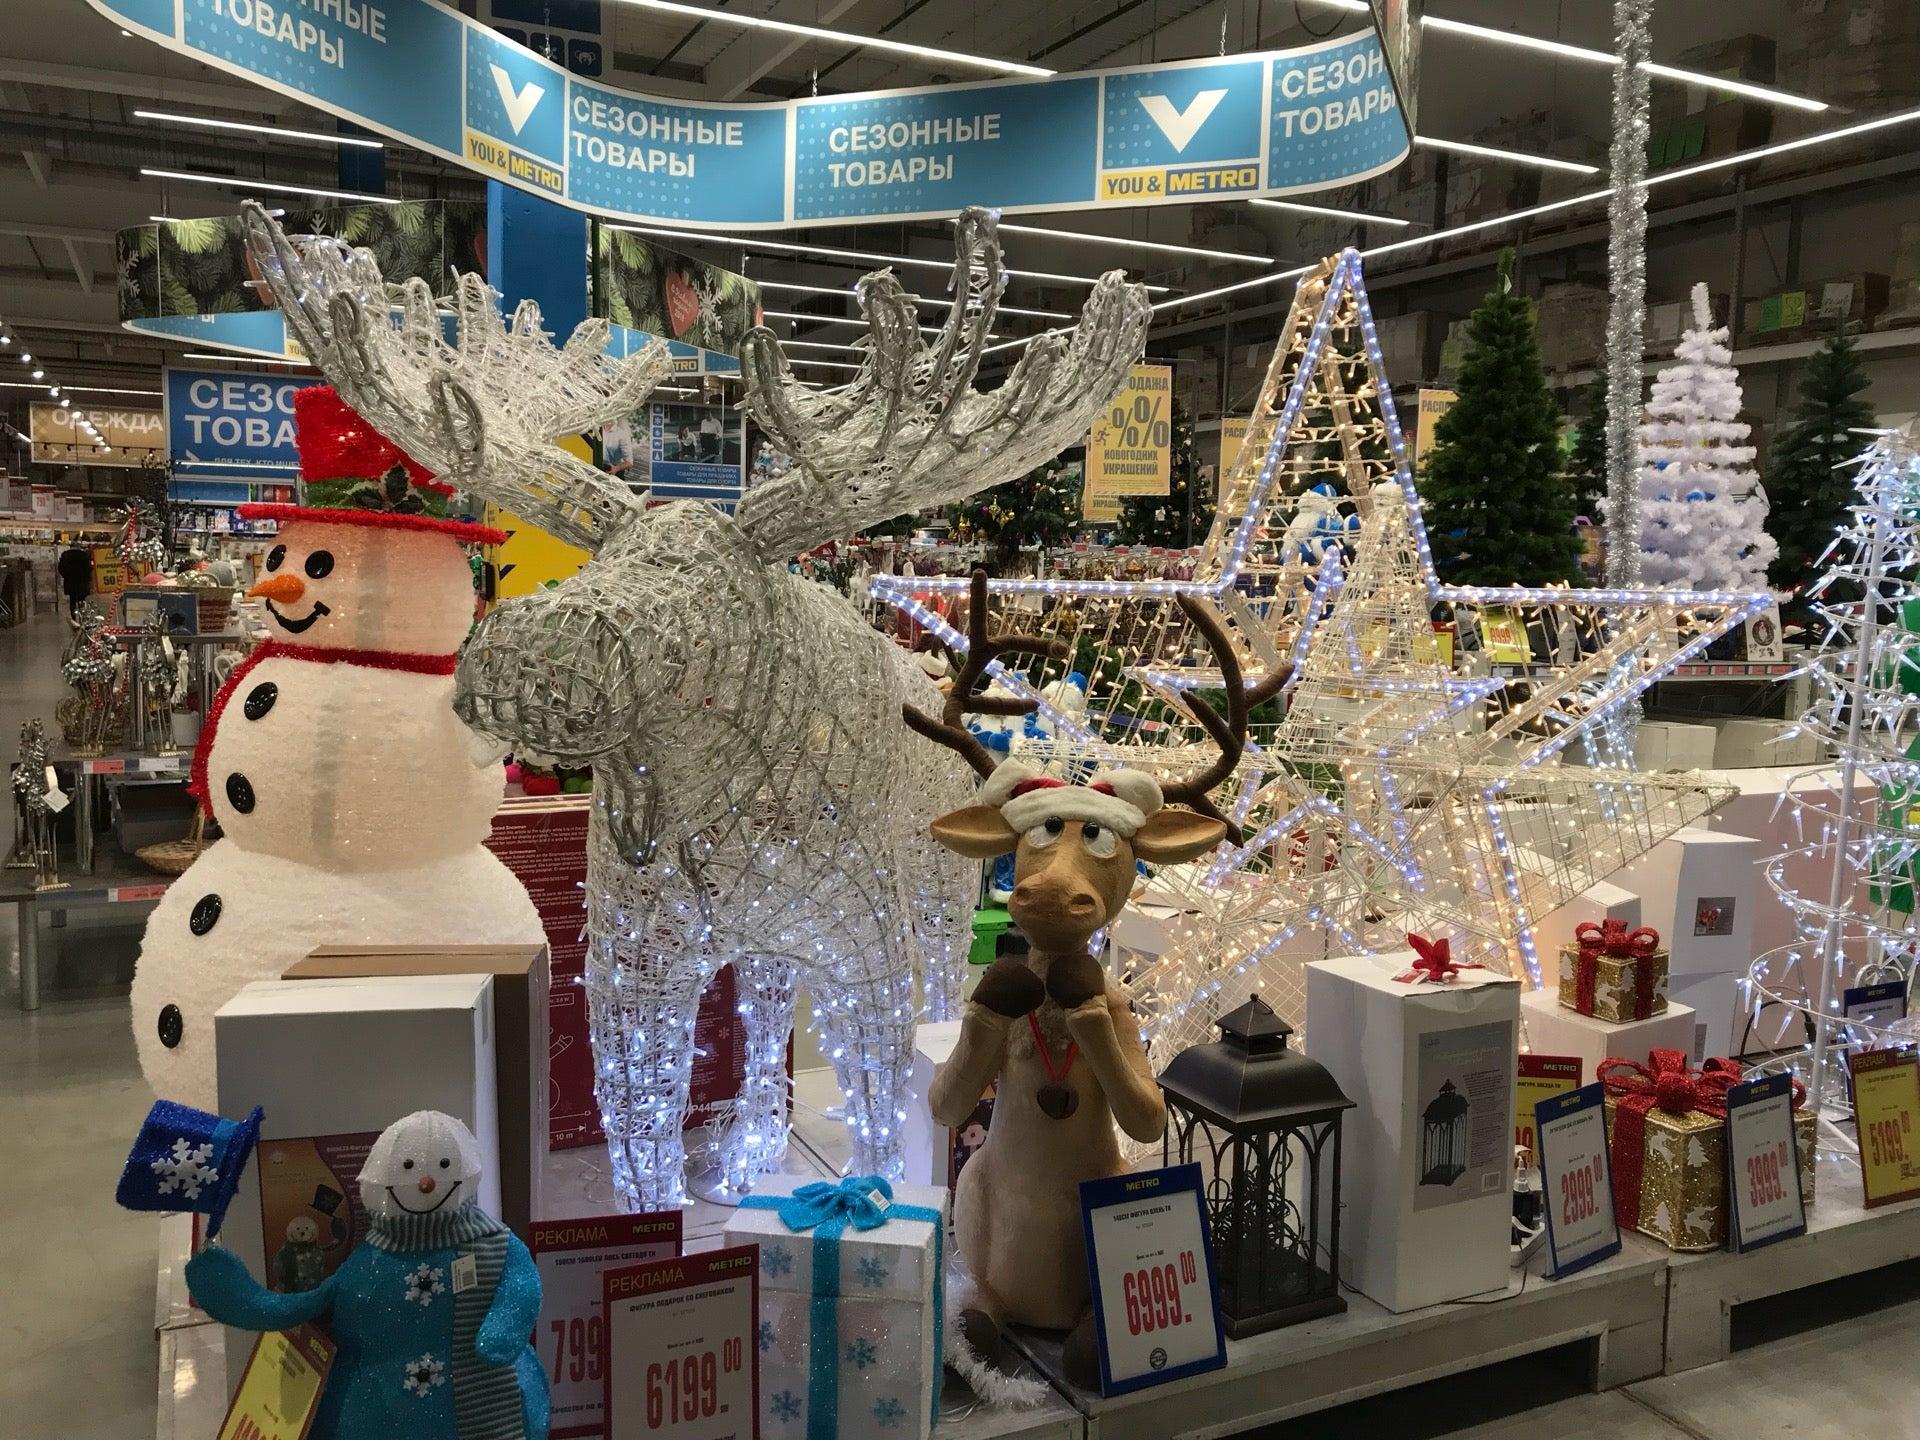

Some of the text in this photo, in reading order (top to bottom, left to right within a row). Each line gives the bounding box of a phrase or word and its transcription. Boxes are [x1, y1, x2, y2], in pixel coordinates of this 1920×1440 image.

[1281, 49, 1387, 98] СЕЗОН
[573, 96, 744, 147] СЕЗОННЫЕ
[828, 113, 1001, 154] СЕЗОННЫЕ
[470, 138, 561, 191] YOU & METRO
[572, 132, 696, 178] ТОВАРЫ
[828, 155, 954, 188] ТОВАРЫ
[1106, 168, 1256, 196] YOU & METRO
[190, 379, 298, 414] СЕЗО
[184, 414, 300, 448] ТОВА
[1543, 1063, 1577, 1072] METRO
[1126, 1178, 1160, 1191] METRO
[534, 1227, 608, 1246] РЕКЛАМА
[632, 1222, 675, 1234] METRO
[609, 1268, 685, 1293] РЕКЛАМА
[708, 1256, 752, 1272] METRO
[1180, 1250, 1197, 1285] 00
[723, 1336, 742, 1373] 00
